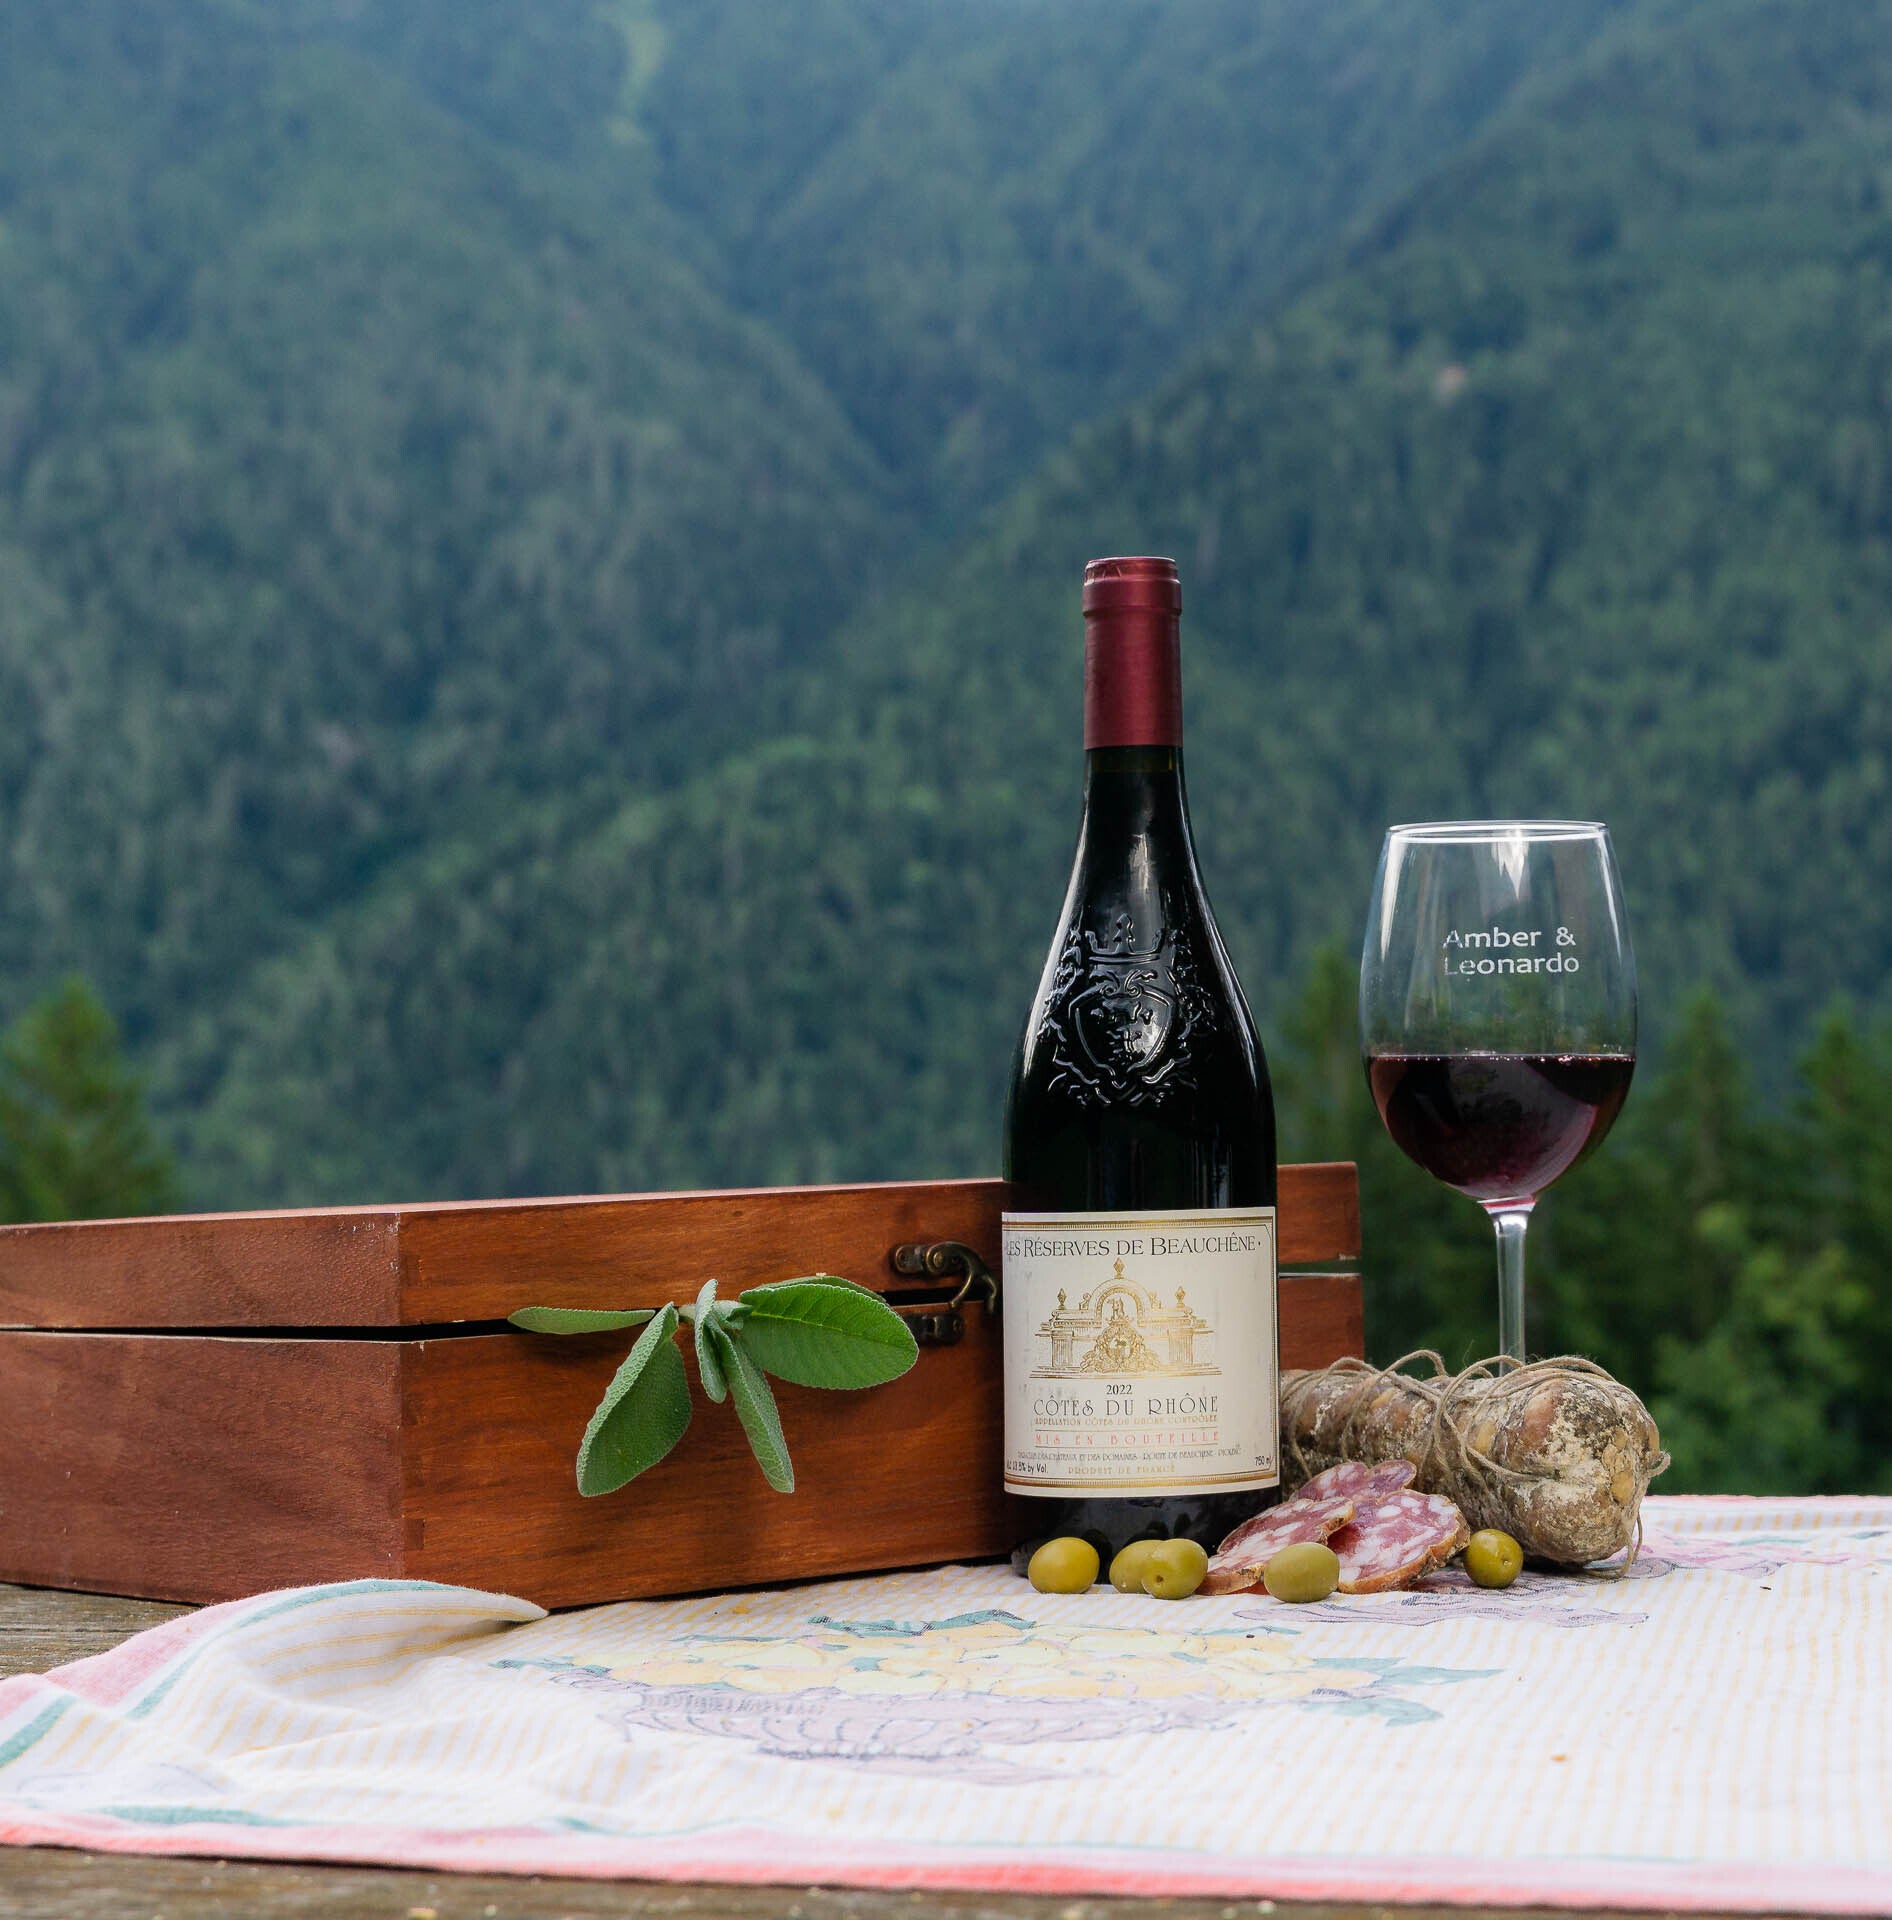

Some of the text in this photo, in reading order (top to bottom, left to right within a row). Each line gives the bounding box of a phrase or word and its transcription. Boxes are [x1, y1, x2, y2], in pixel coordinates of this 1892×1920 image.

[1442, 926, 1577, 949] Amber &
[1443, 951, 1580, 977] Leonardo
[1023, 1236, 1110, 1257] RÉSERVES
[1117, 1239, 1144, 1256] DE
[1150, 1231, 1256, 1256] BEAUCHÊNE
[1106, 1384, 1133, 1395] 2022
[1033, 1392, 1218, 1416] CÔTES DU RHÔNE
[1035, 1431, 1219, 1445] MIS EN BOUTEILLE
[1027, 1462, 1034, 1476] by
